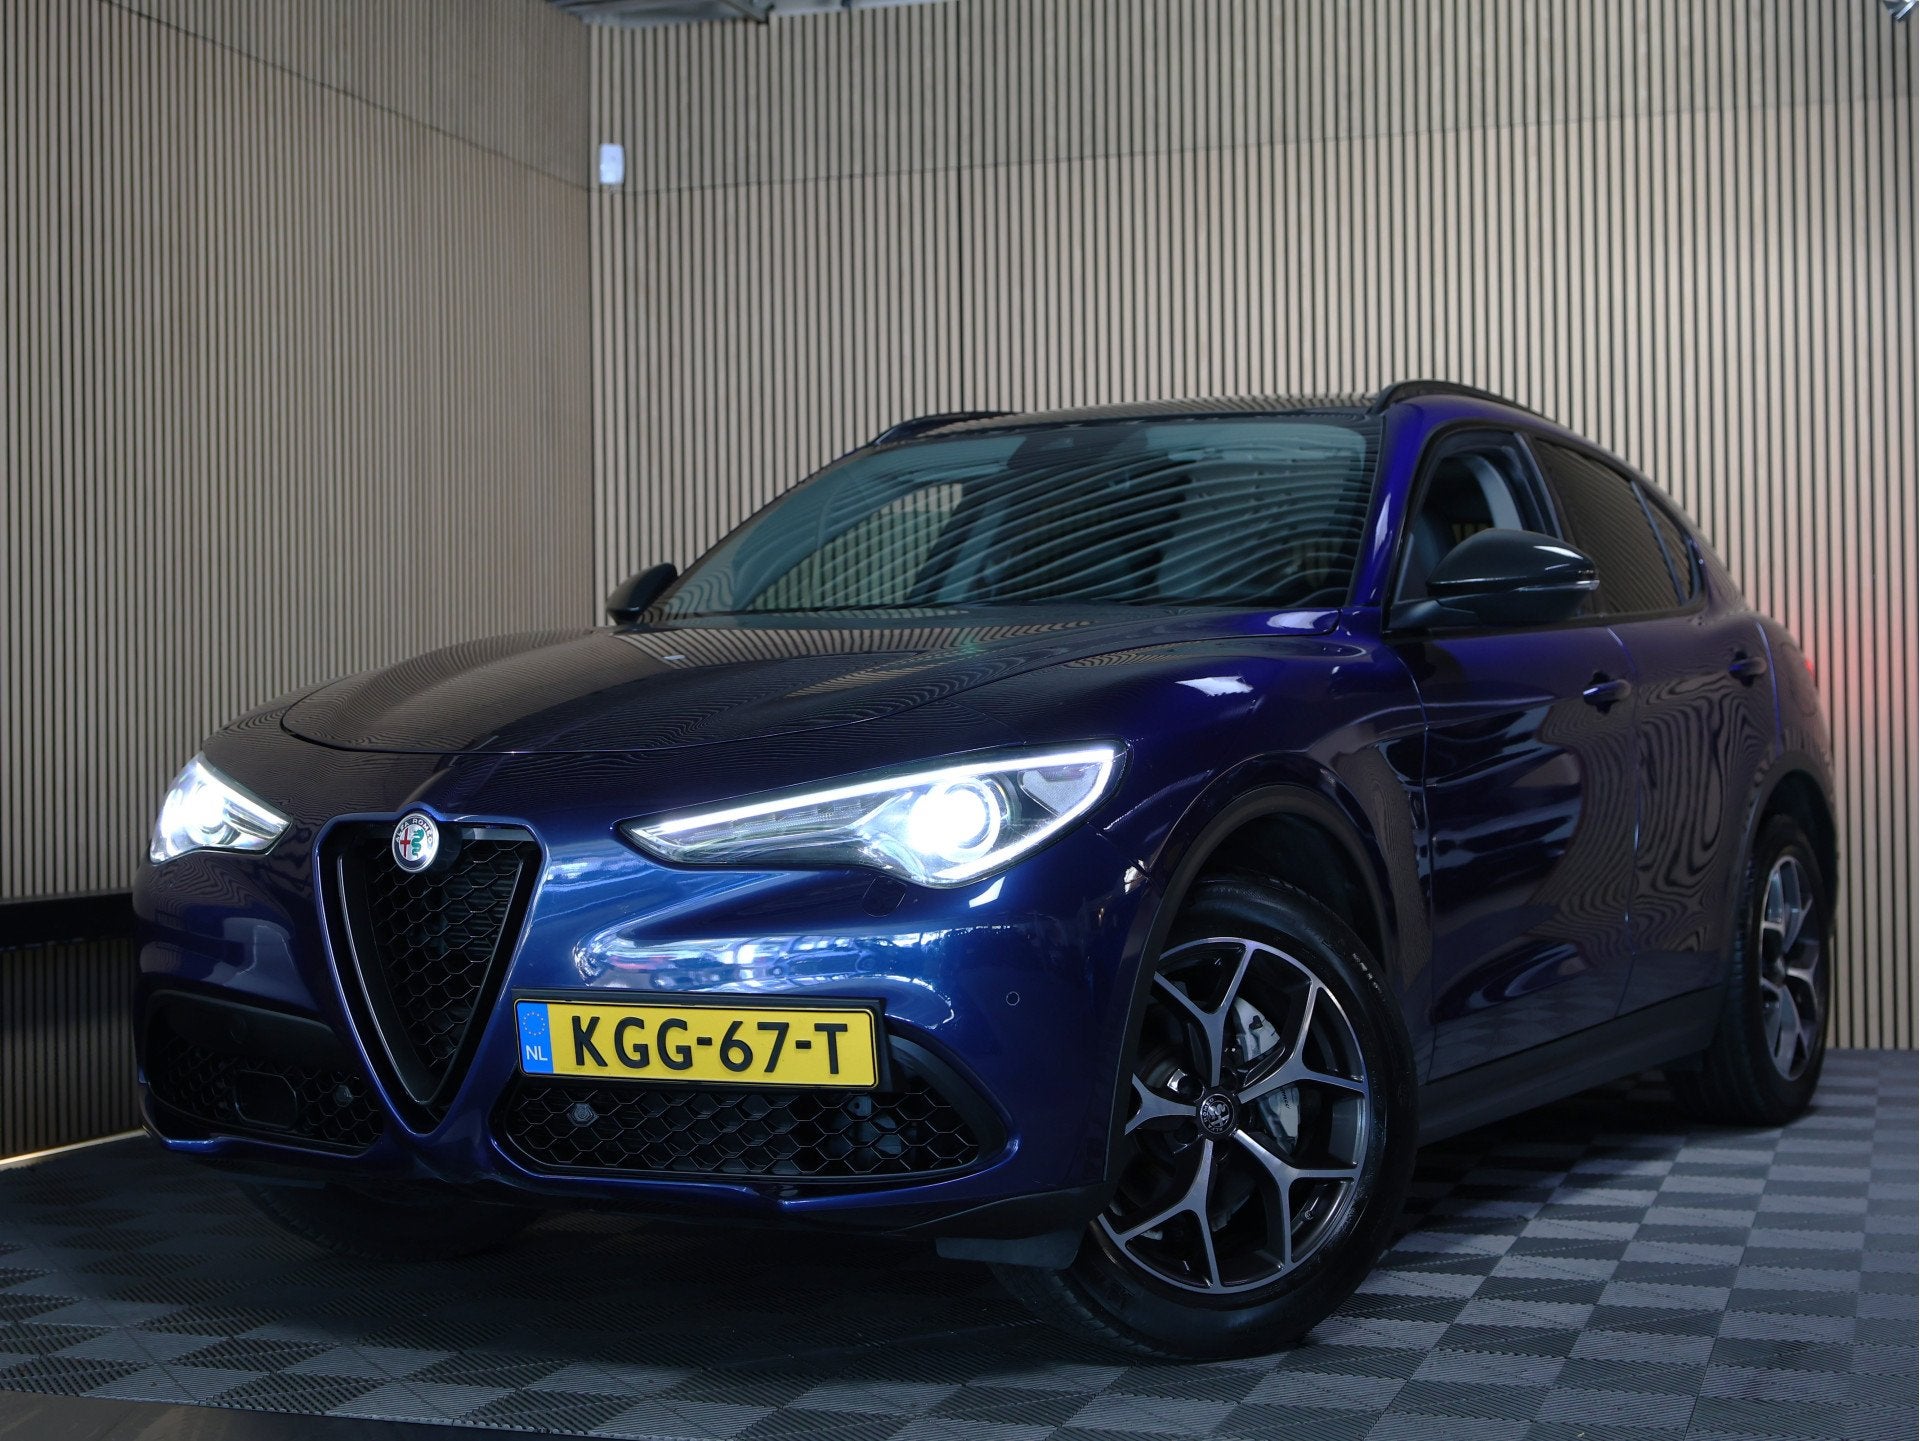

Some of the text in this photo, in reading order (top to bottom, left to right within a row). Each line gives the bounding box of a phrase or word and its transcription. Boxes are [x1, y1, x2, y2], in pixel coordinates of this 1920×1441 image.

[396, 818, 433, 844] ALFA ROMEO
[525, 1045, 548, 1061] NL
[571, 1015, 848, 1075] KGG-67-T
